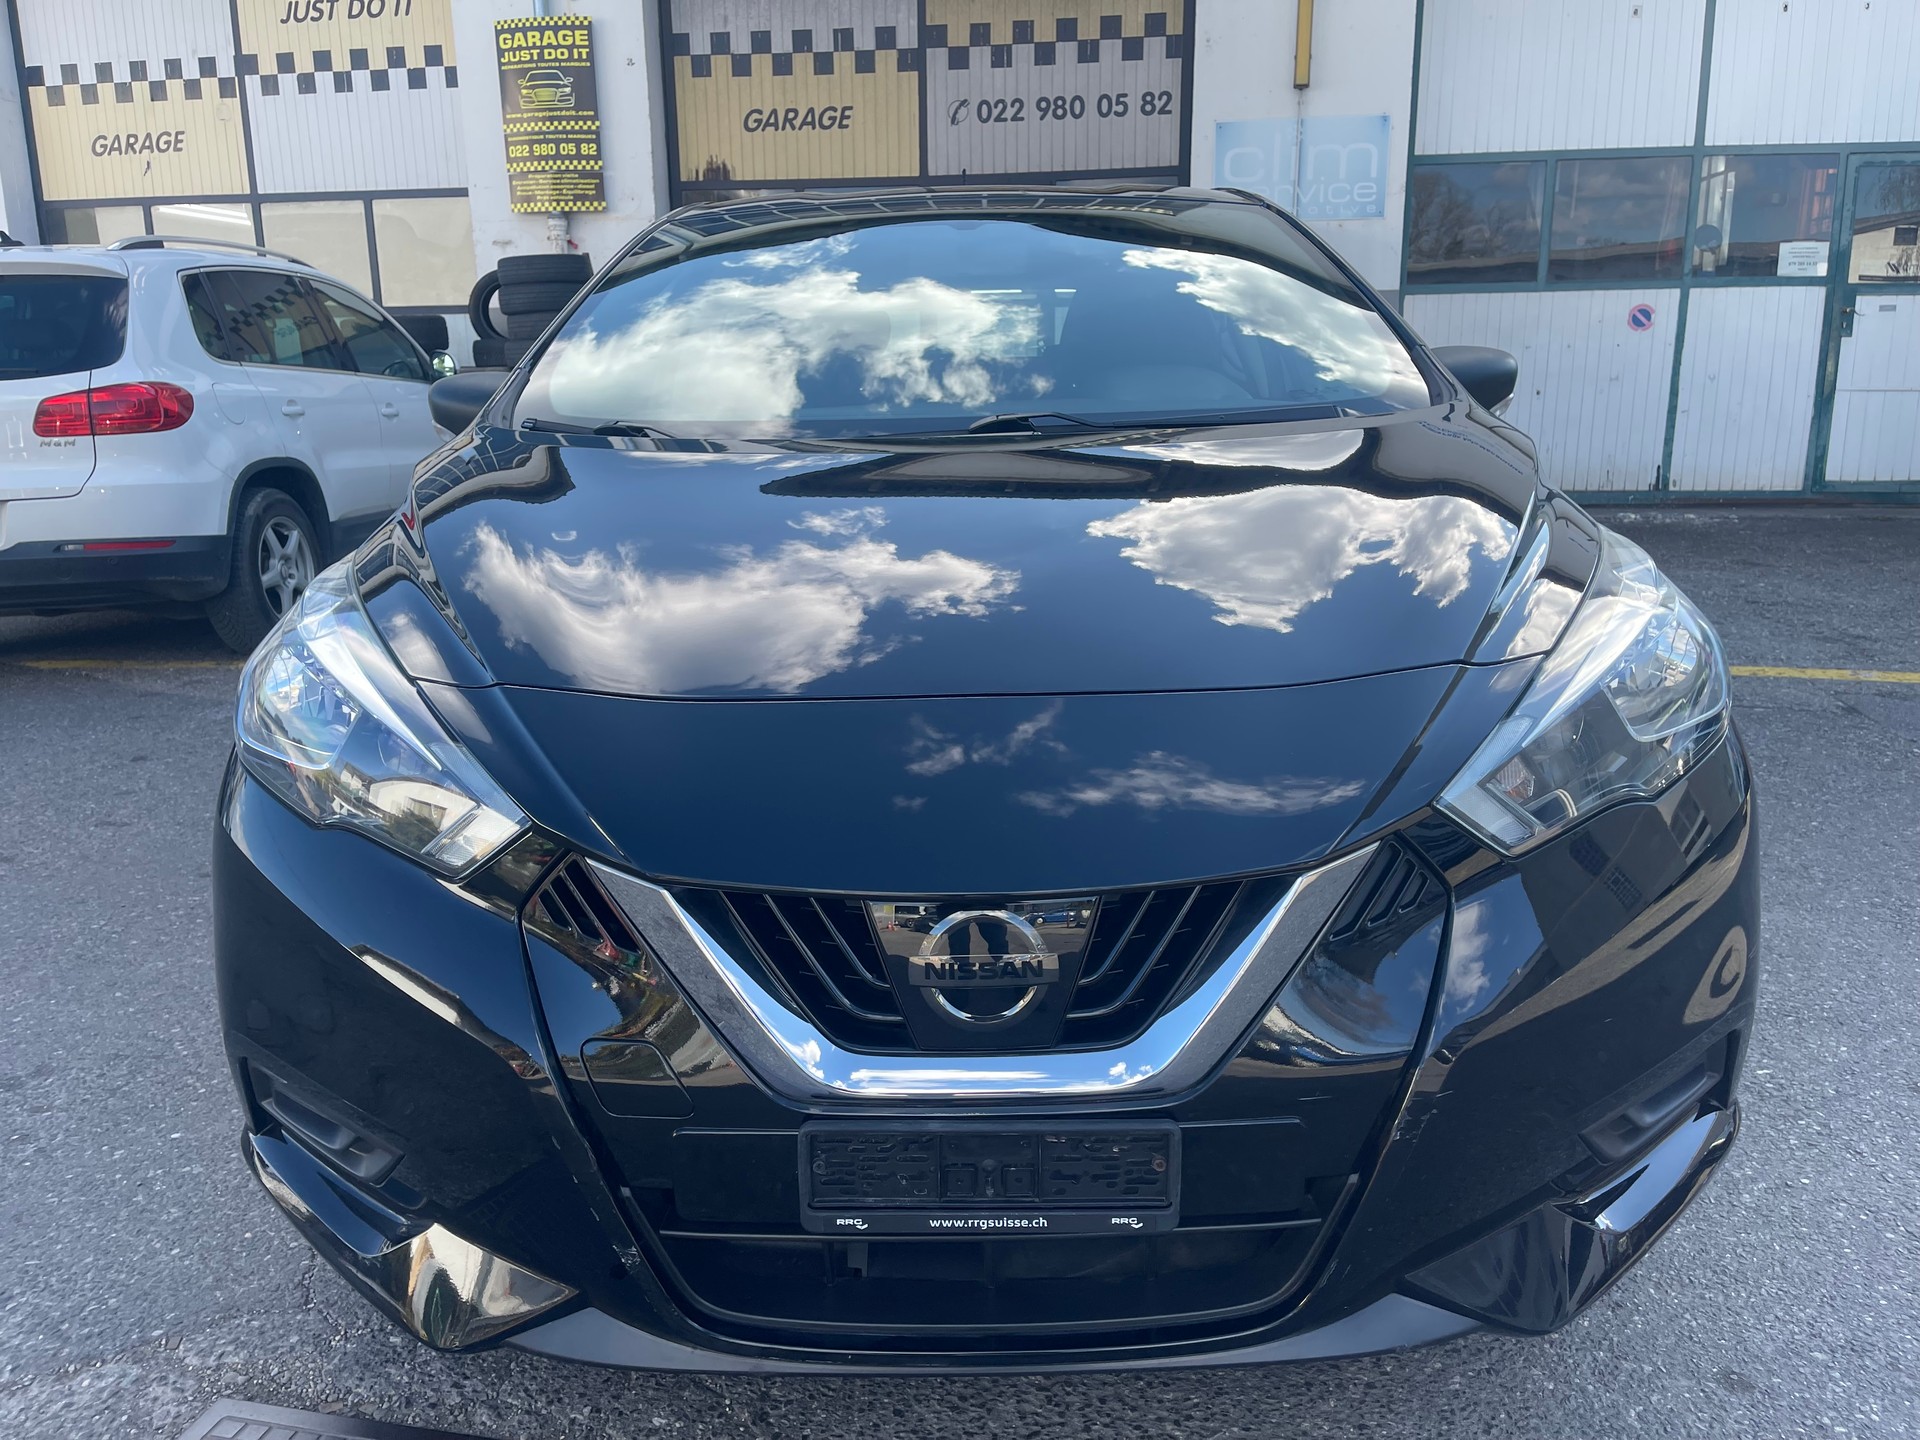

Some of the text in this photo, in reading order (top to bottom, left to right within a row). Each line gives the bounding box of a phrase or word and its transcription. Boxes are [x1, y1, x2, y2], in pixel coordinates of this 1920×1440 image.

[280, 0, 339, 24] JUST
[348, 0, 385, 19] DO
[499, 30, 589, 49] GARAGE
[501, 48, 590, 63] JUST DO IT
[976, 90, 1173, 124] 022 980 05 82
[743, 105, 854, 132] GARAGE
[91, 131, 185, 157] GARAGE
[509, 143, 598, 157] 022 980 05 82
[1224, 130, 1378, 182] clim
[924, 960, 1044, 980] NISSAN
[836, 1216, 1139, 1229] RRG www.rrgsuisse.ch RRG
